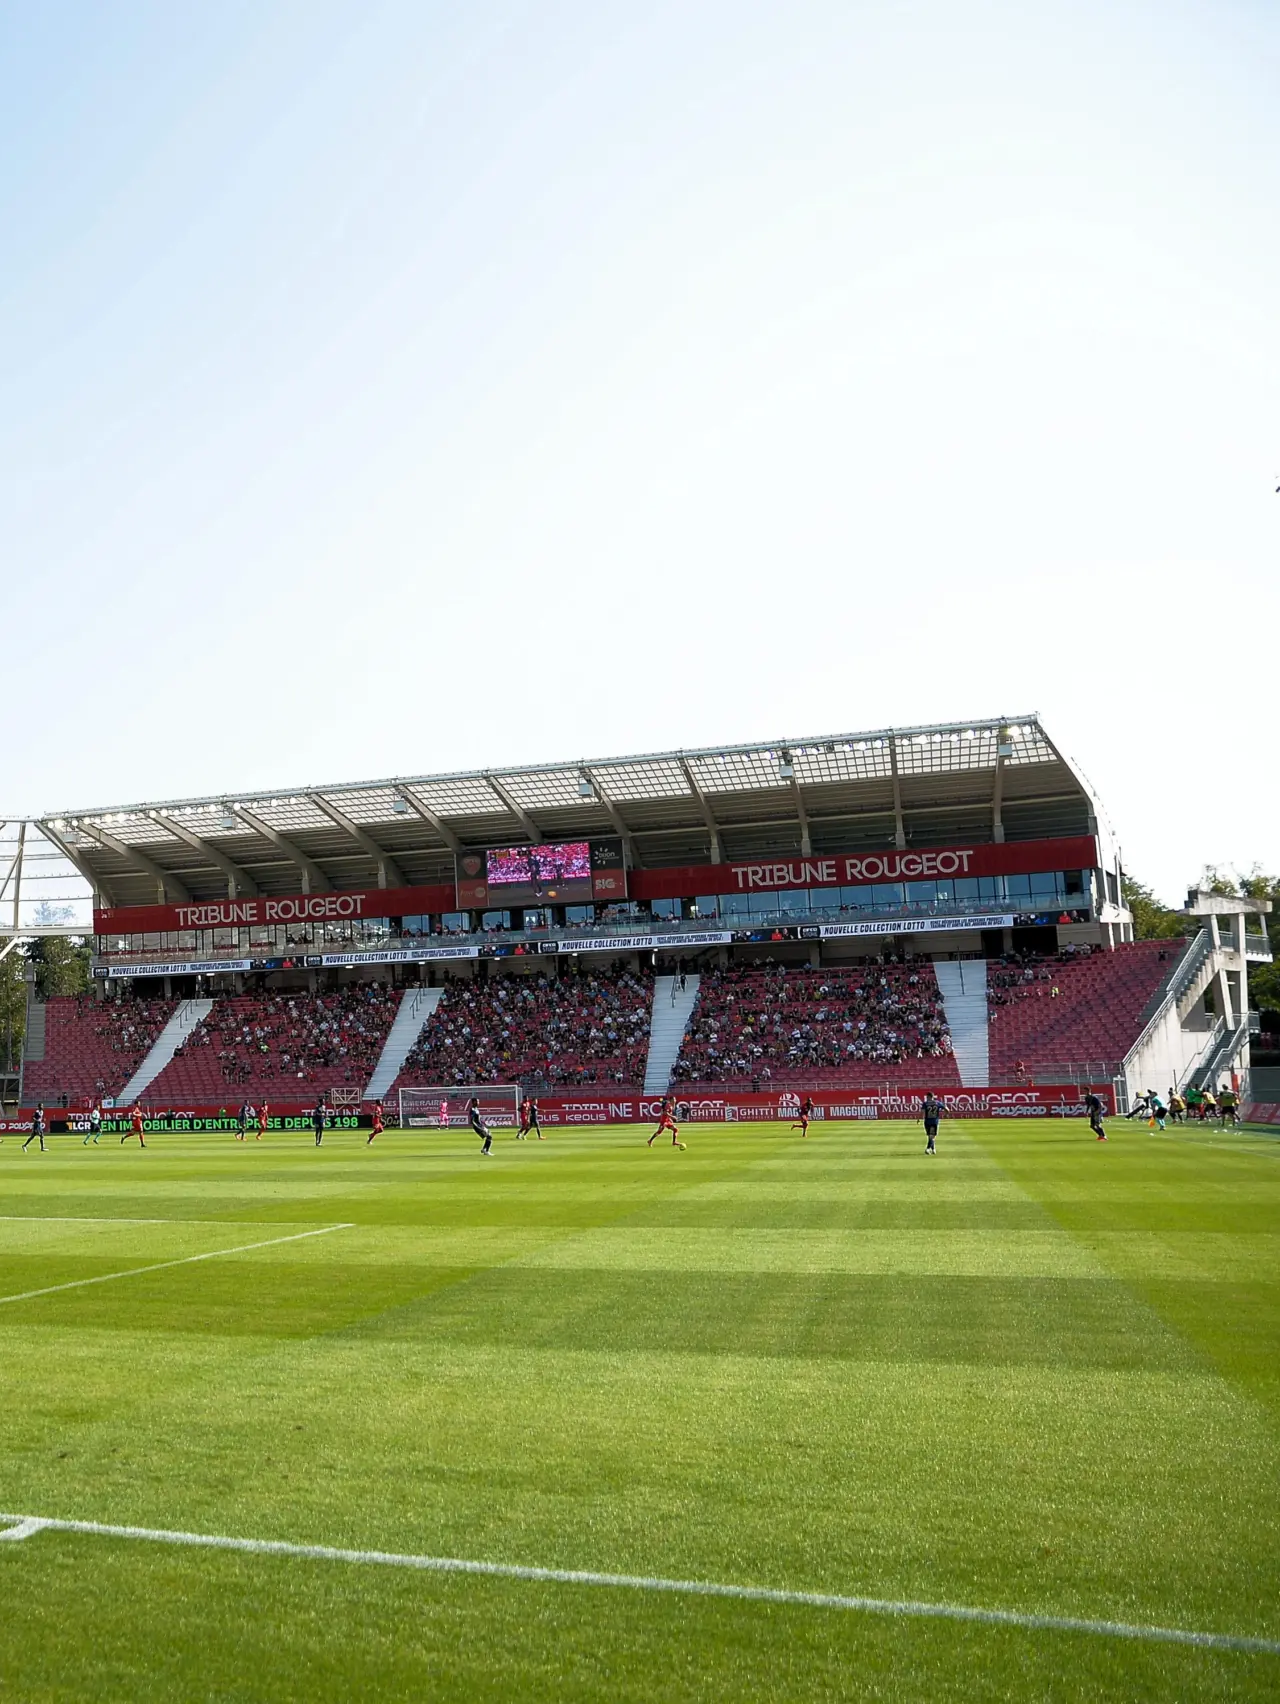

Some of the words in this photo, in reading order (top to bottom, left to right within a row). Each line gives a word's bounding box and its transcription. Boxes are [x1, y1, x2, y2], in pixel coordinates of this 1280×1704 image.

[732, 861, 837, 888] TRIBUNE
[845, 850, 973, 880] ROUGEOT
[175, 902, 258, 926] TRIBUNE
[266, 895, 366, 920] ROUGEOT
[824, 924, 858, 935] NOUVELLE
[859, 922, 901, 933] COLLECTION
[903, 921, 925, 931] LOTTO
[561, 940, 592, 950] NOUVELLE
[593, 938, 631, 948] COLLECTION
[632, 937, 653, 946] LOTTO
[325, 954, 354, 963] NOUVELLE
[354, 952, 388, 962] COLLECTION
[389, 951, 408, 960] LOTTO
[111, 966, 138, 975] NOUVELLE
[139, 965, 170, 974] COLLECTION
[170, 964, 187, 973] LOTTO
[690, 1108, 724, 1116] GHITTI
[740, 1108, 773, 1116] GHITTI
[830, 1106, 878, 1116] MAGGIONI
[881, 1103, 921, 1113] MAISO
[927, 1105, 938, 1117] 22
[101, 1121, 116, 1131] EN
[120, 1119, 191, 1131] IMOBILIER
[285, 1117, 332, 1129] DEPUS
[334, 1116, 359, 1128] 198
